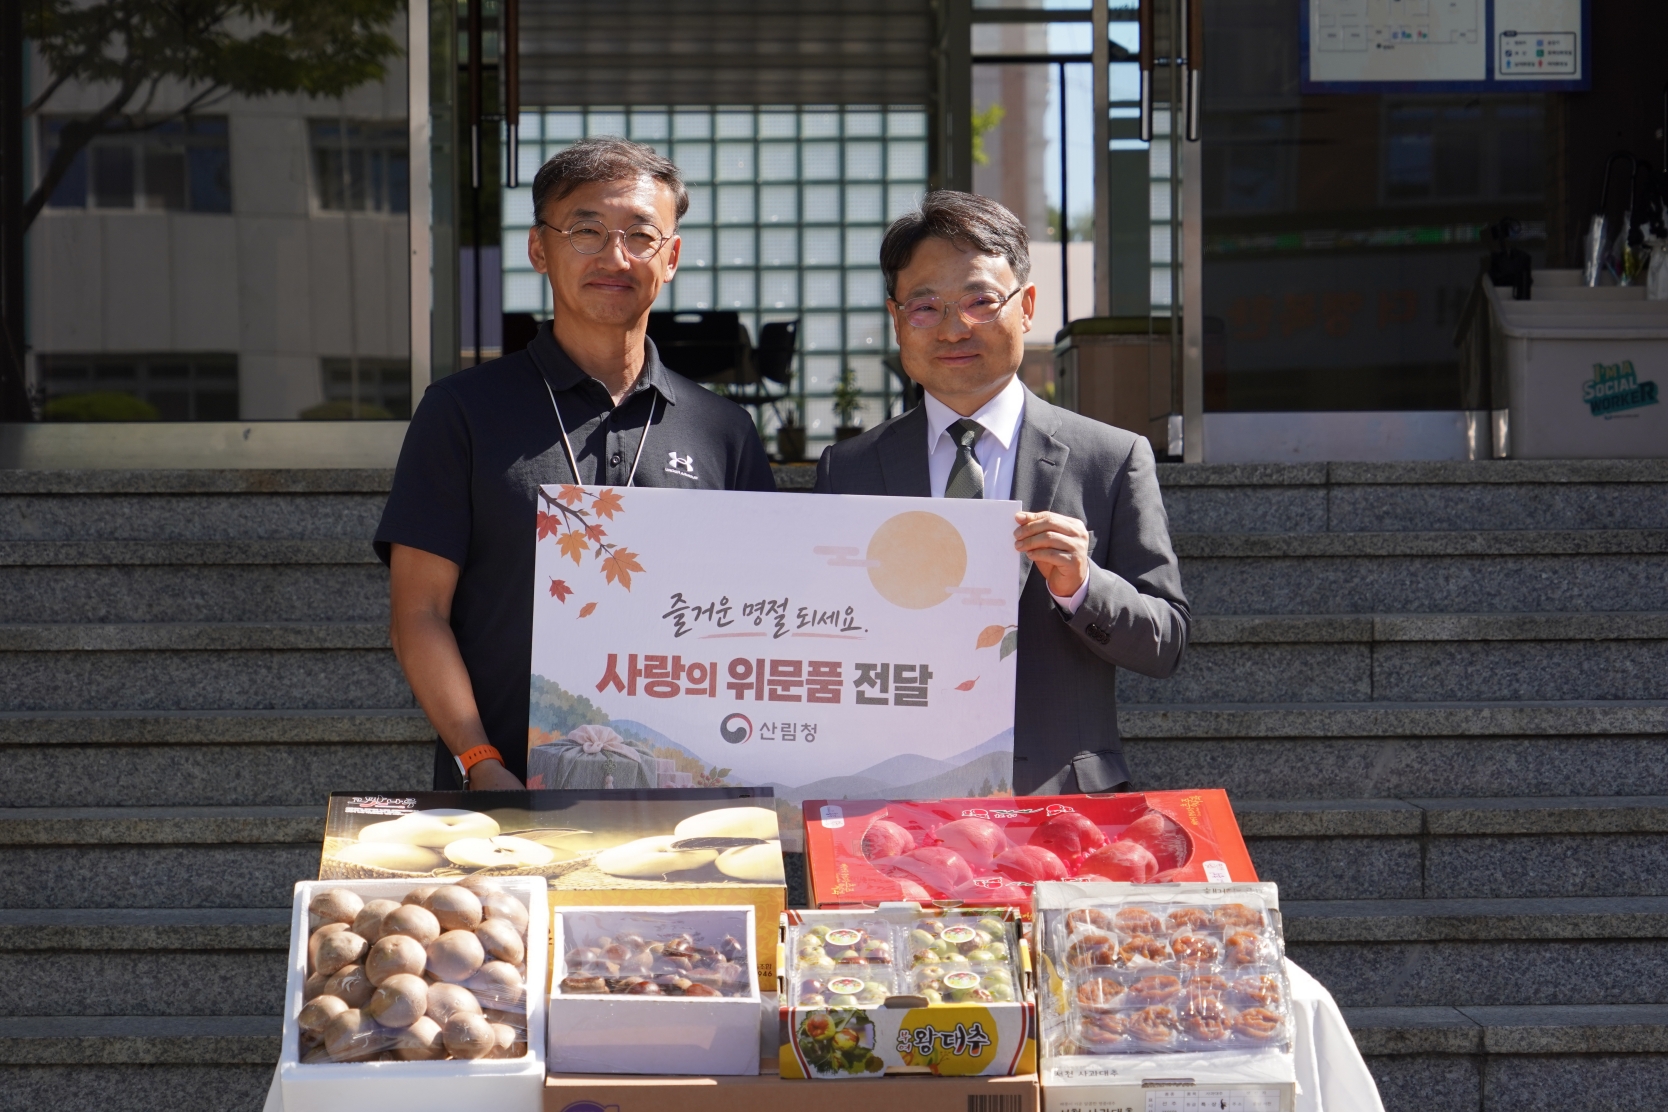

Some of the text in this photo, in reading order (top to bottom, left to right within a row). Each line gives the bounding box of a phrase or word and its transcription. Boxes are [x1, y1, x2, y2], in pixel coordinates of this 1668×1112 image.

[1593, 360, 1633, 382] I'M A
[1583, 376, 1637, 399] SOCIAL
[1590, 381, 1657, 413] WORKER
[662, 592, 734, 638] 즐거운
[742, 597, 791, 639] 명절
[595, 653, 934, 707] 사랑의 위문품 전달
[758, 721, 818, 743] 산림청
[914, 1023, 990, 1057] 왕대추
[1078, 1069, 1119, 1077] 사과대추
